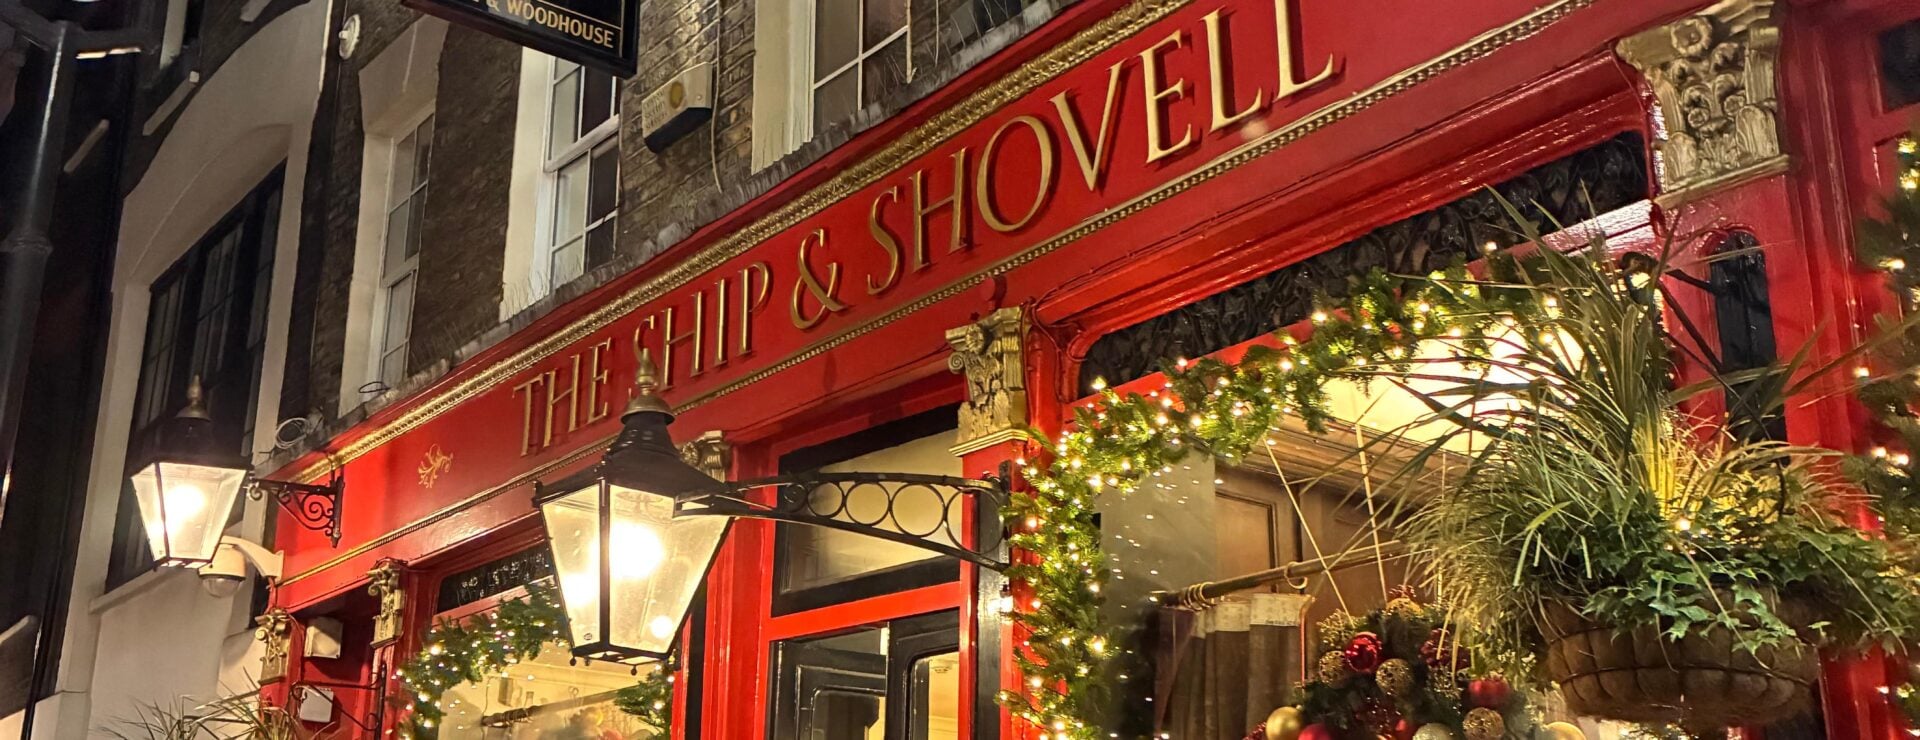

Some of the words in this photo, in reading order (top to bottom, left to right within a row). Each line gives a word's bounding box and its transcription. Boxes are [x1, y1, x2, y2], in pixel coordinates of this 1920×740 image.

[506, 0, 615, 48] WOODHOUSE
[512, 336, 612, 457] THE
[790, 228, 846, 330] &
[867, 0, 1334, 296] SHOVELL
